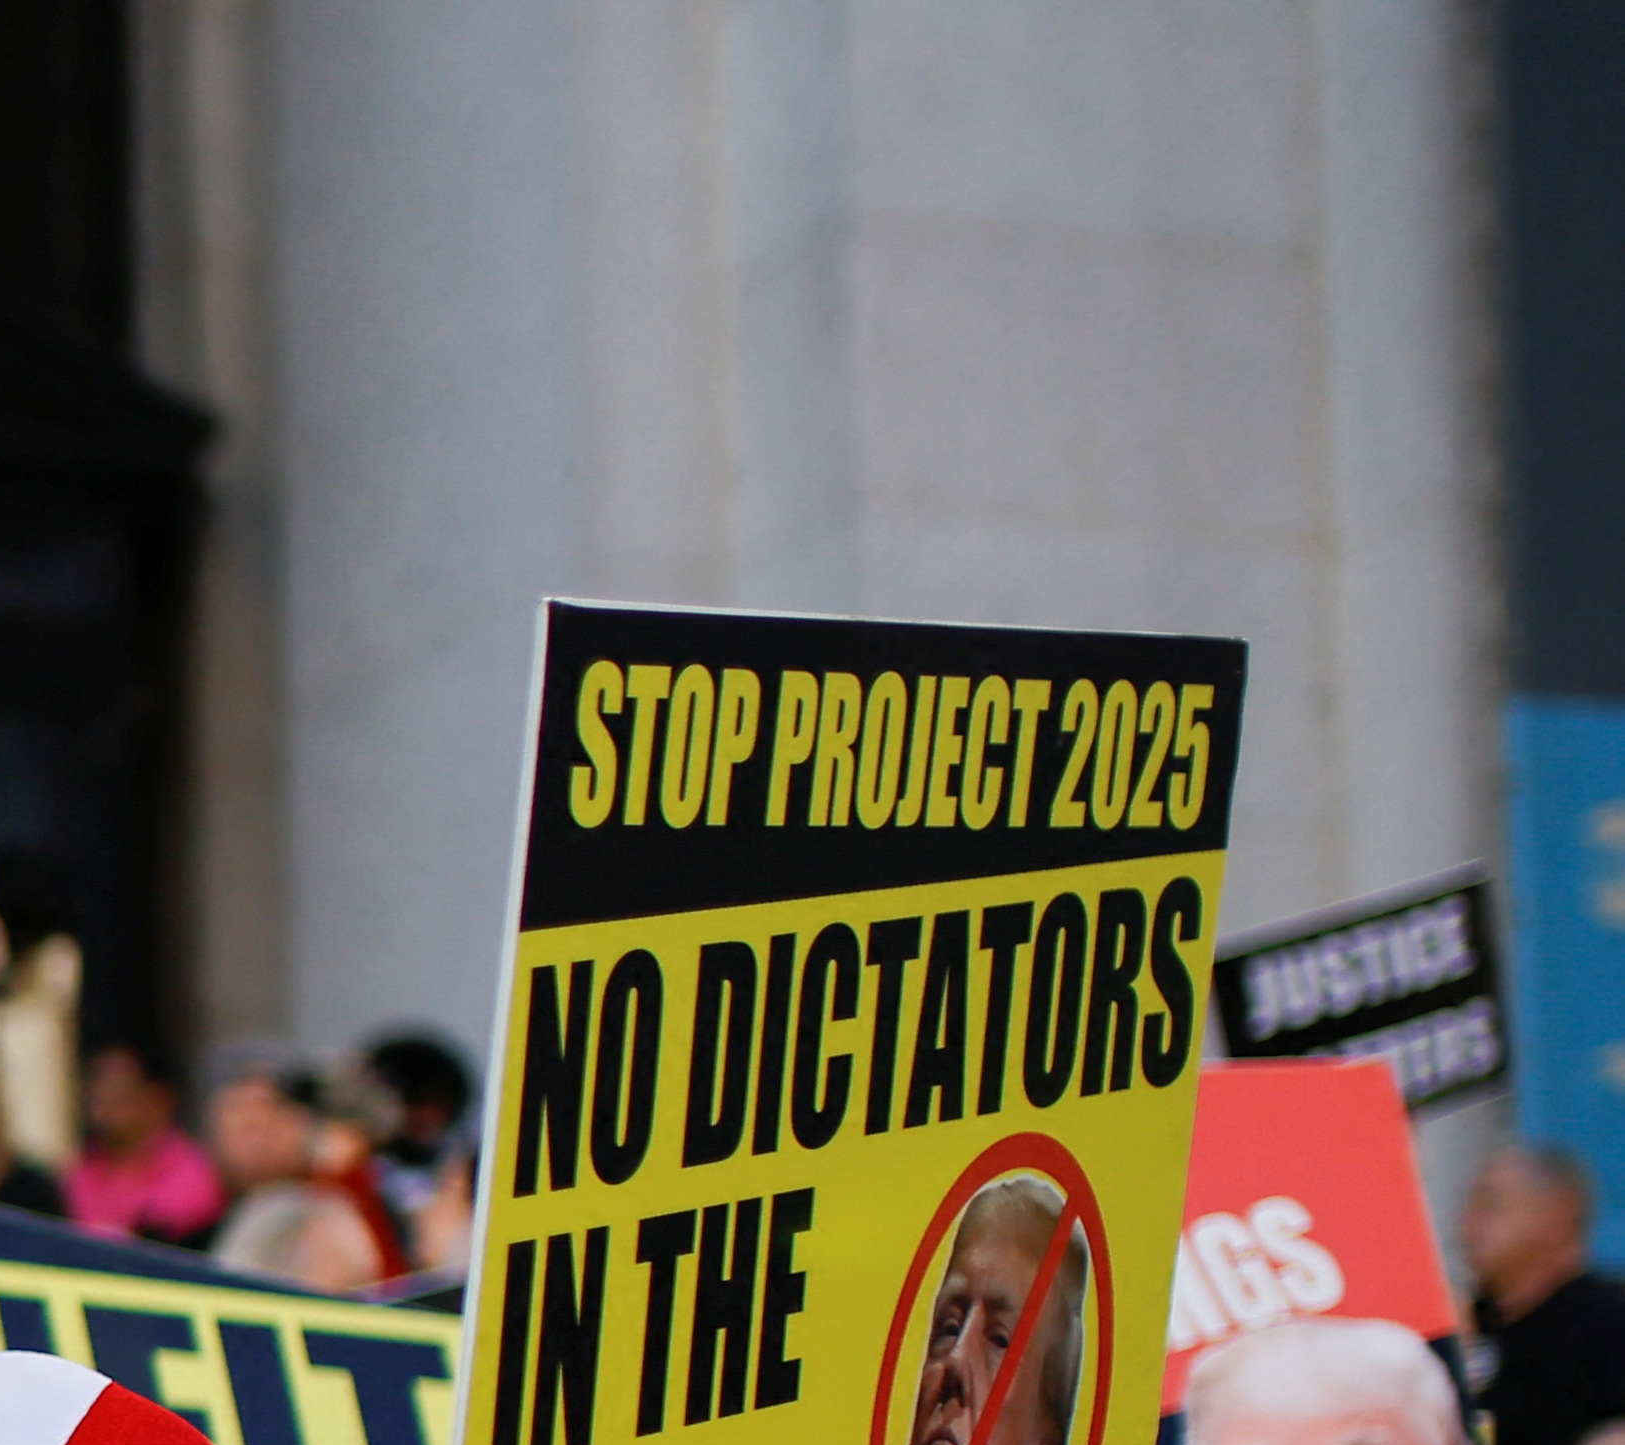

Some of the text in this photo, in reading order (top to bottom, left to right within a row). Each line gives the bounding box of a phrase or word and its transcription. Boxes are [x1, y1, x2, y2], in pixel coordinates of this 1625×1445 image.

[569, 659, 1214, 831] STOP PROJECT 2025
[513, 876, 1203, 1197] NO DICTATORS
[1245, 898, 1477, 1040] JUSTICE
[636, 1187, 815, 1438] THE
